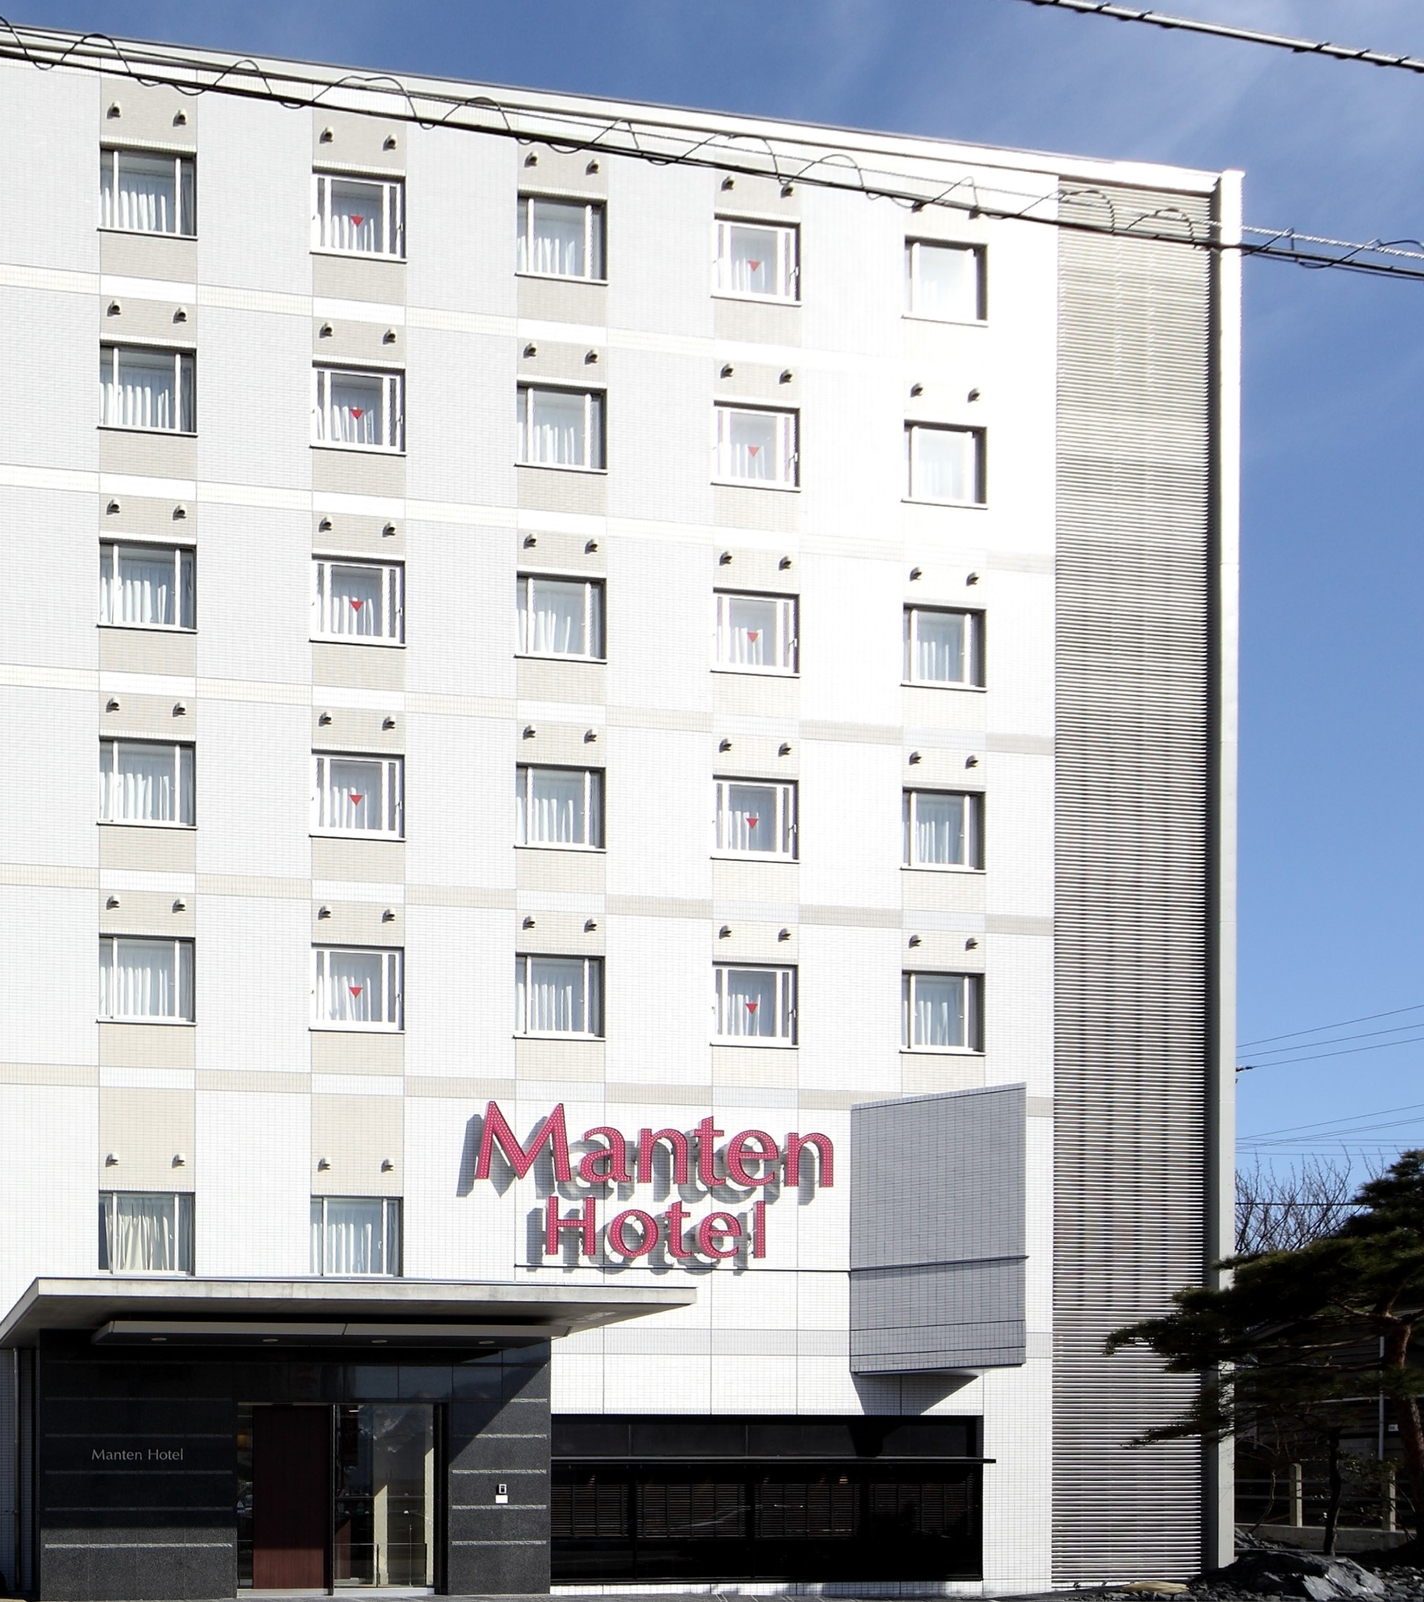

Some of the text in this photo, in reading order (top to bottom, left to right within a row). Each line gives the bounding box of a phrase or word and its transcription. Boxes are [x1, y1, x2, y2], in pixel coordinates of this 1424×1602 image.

[475, 1100, 834, 1188] Manten
[544, 1195, 767, 1260] Hotel
[91, 1448, 184, 1461] Manten Hotel
